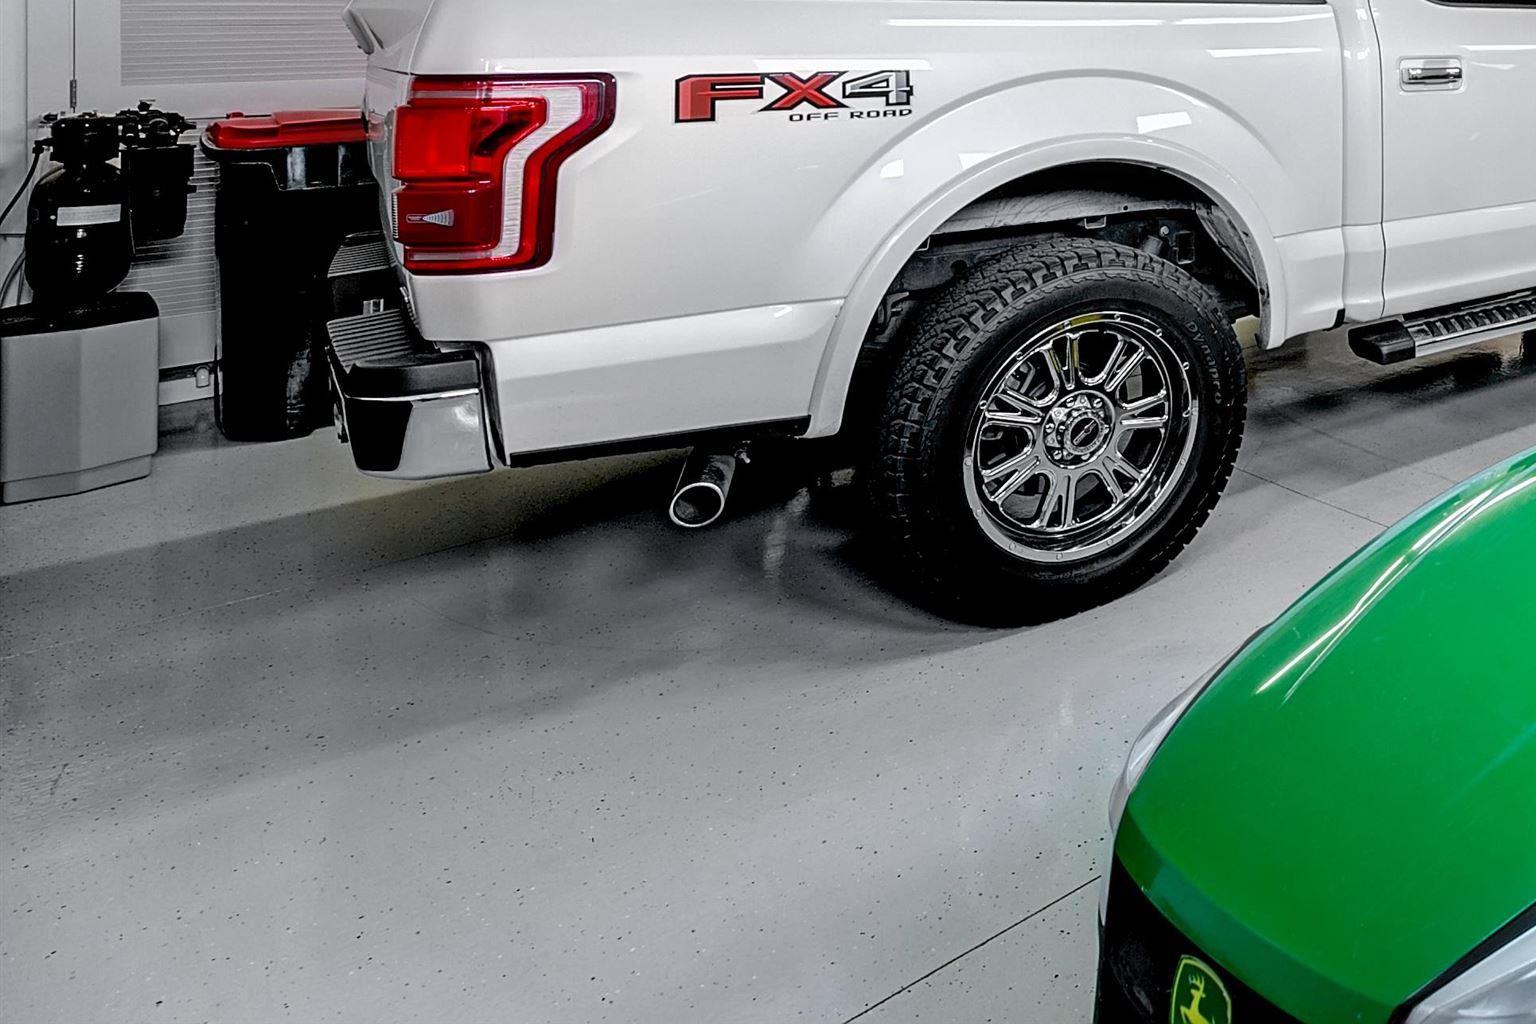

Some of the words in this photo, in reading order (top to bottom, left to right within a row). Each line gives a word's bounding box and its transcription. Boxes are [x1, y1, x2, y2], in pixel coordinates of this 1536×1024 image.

[674, 70, 913, 123] FX4
[788, 112, 839, 122] OFF
[850, 109, 913, 119] ROAD
[1184, 321, 1222, 405] Dynapro
